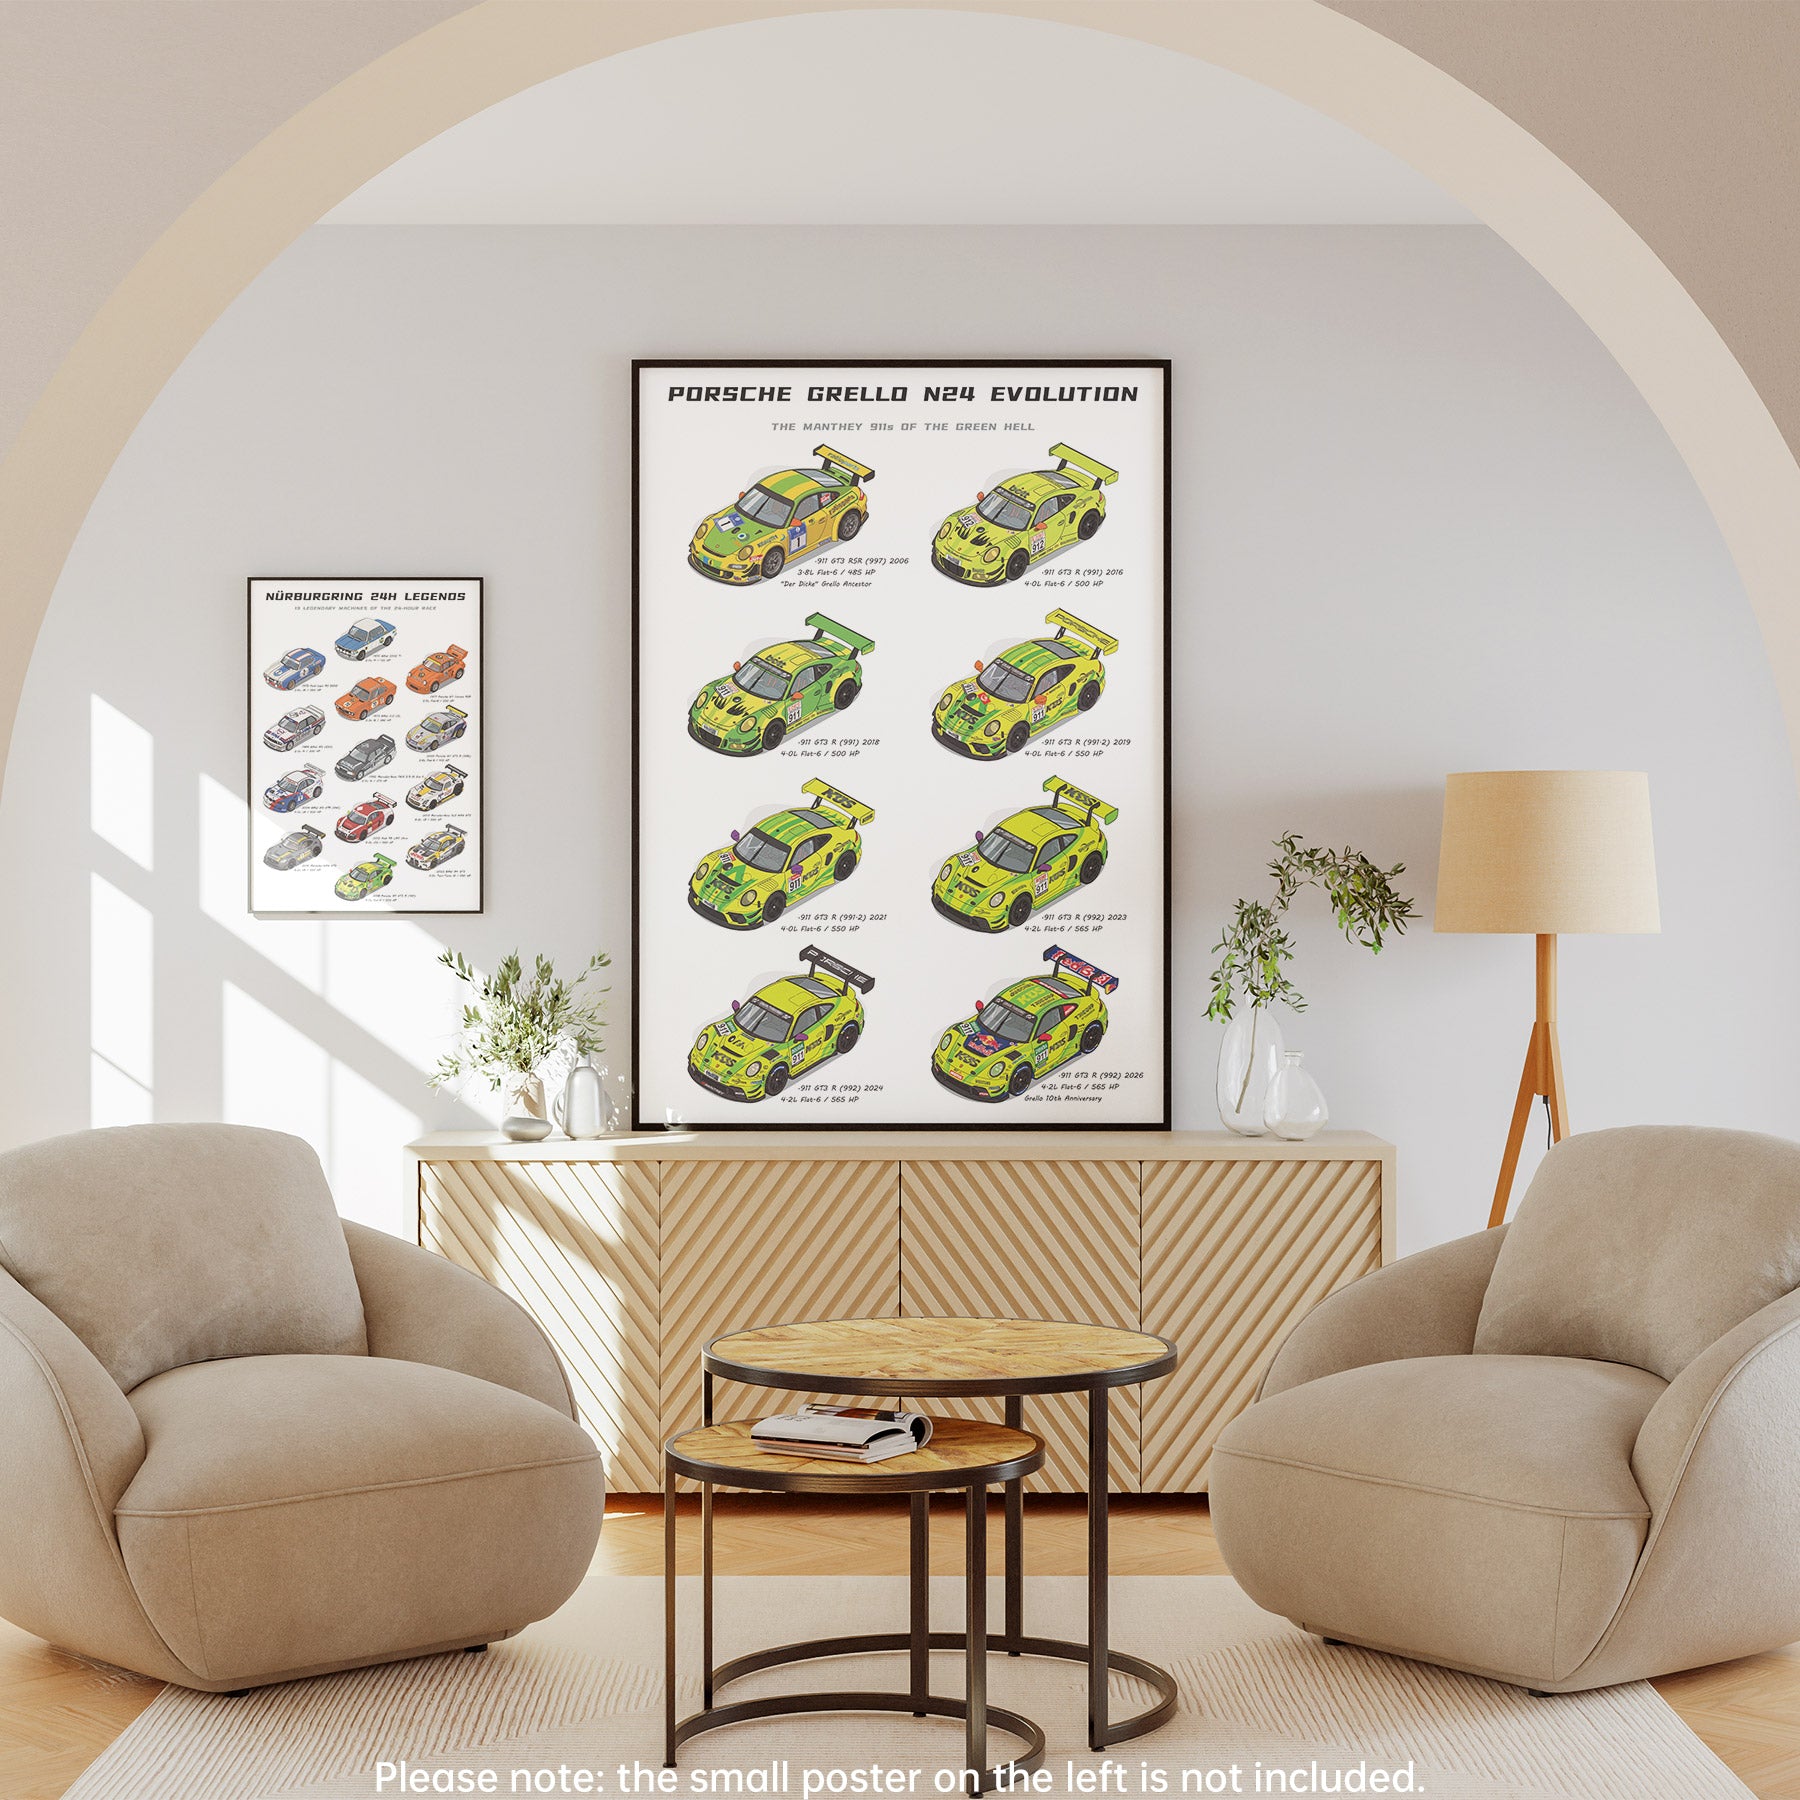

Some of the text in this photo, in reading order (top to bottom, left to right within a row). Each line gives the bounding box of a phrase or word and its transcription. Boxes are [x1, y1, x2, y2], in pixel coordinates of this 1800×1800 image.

[668, 387, 1138, 401] PORSCHE GRELLO N24 EVOLUTION
[771, 422, 1036, 432] THE MANTHEY 911s OF THE GREEN HELL
[1032, 540, 1045, 553] 912
[831, 557, 845, 565] GT3
[848, 556, 862, 565] RSR
[865, 557, 886, 566] (997)
[890, 557, 909, 565] 2006
[817, 568, 838, 576] Flat-6
[848, 568, 862, 576] 485
[865, 568, 876, 576] HP
[1058, 568, 1072, 576] GT3
[1075, 568, 1080, 576] R
[1083, 568, 1102, 578] (991)
[1106, 568, 1123, 576] 2016
[821, 580, 840, 588] Grello
[843, 580, 872, 588] Ancestor
[1045, 580, 1065, 588] Flat-6
[1075, 580, 1090, 588] 500
[1093, 579, 1103, 587] HP
[266, 591, 363, 600] NÜRBURGRING
[788, 710, 801, 723] 911
[1033, 709, 1045, 722] 911
[814, 738, 828, 746] GT3
[832, 738, 836, 746] R
[840, 738, 859, 748] (991)
[862, 738, 880, 746] 2018
[1058, 738, 1072, 746] GT3
[1075, 738, 1080, 746] R
[1113, 738, 1131, 746] 2019
[801, 750, 821, 758] Flat-6
[831, 750, 846, 758] 500
[849, 749, 860, 757] HP
[1045, 750, 1065, 758] Flat-6
[1075, 750, 1090, 758] 550
[1093, 749, 1103, 757] HP
[789, 878, 801, 892] 911
[1035, 881, 1048, 894] 911
[814, 913, 828, 921] GT3
[831, 913, 836, 921] R
[870, 913, 887, 921] 2021
[1058, 913, 1071, 921] GT3
[1075, 913, 1080, 921] R
[1083, 913, 1104, 923] (992)
[1108, 913, 1127, 921] 2023
[801, 925, 821, 933] Flat-6
[831, 925, 846, 933] 550
[849, 924, 860, 932] HP
[1044, 925, 1064, 933] Flat-6
[1075, 925, 1089, 933] 565
[1092, 924, 1103, 932] HP
[792, 1051, 805, 1065] 911
[1036, 1050, 1048, 1063] 911
[1075, 1071, 1088, 1079] GT3
[1092, 1071, 1097, 1079] R
[1100, 1071, 1121, 1081] (992)
[1125, 1071, 1144, 1079] 2026
[814, 1084, 828, 1092] GT3
[832, 1084, 836, 1092] R
[840, 1084, 861, 1094] (992)
[864, 1084, 883, 1092] 2024
[1061, 1083, 1081, 1091] Flat-6
[1091, 1083, 1106, 1091] 565
[1109, 1082, 1120, 1090] HP
[800, 1095, 821, 1103] Flat-6
[831, 1095, 845, 1103] 565
[849, 1095, 859, 1103] HP
[1024, 1094, 1102, 1104] Grello 10th Anniversary
